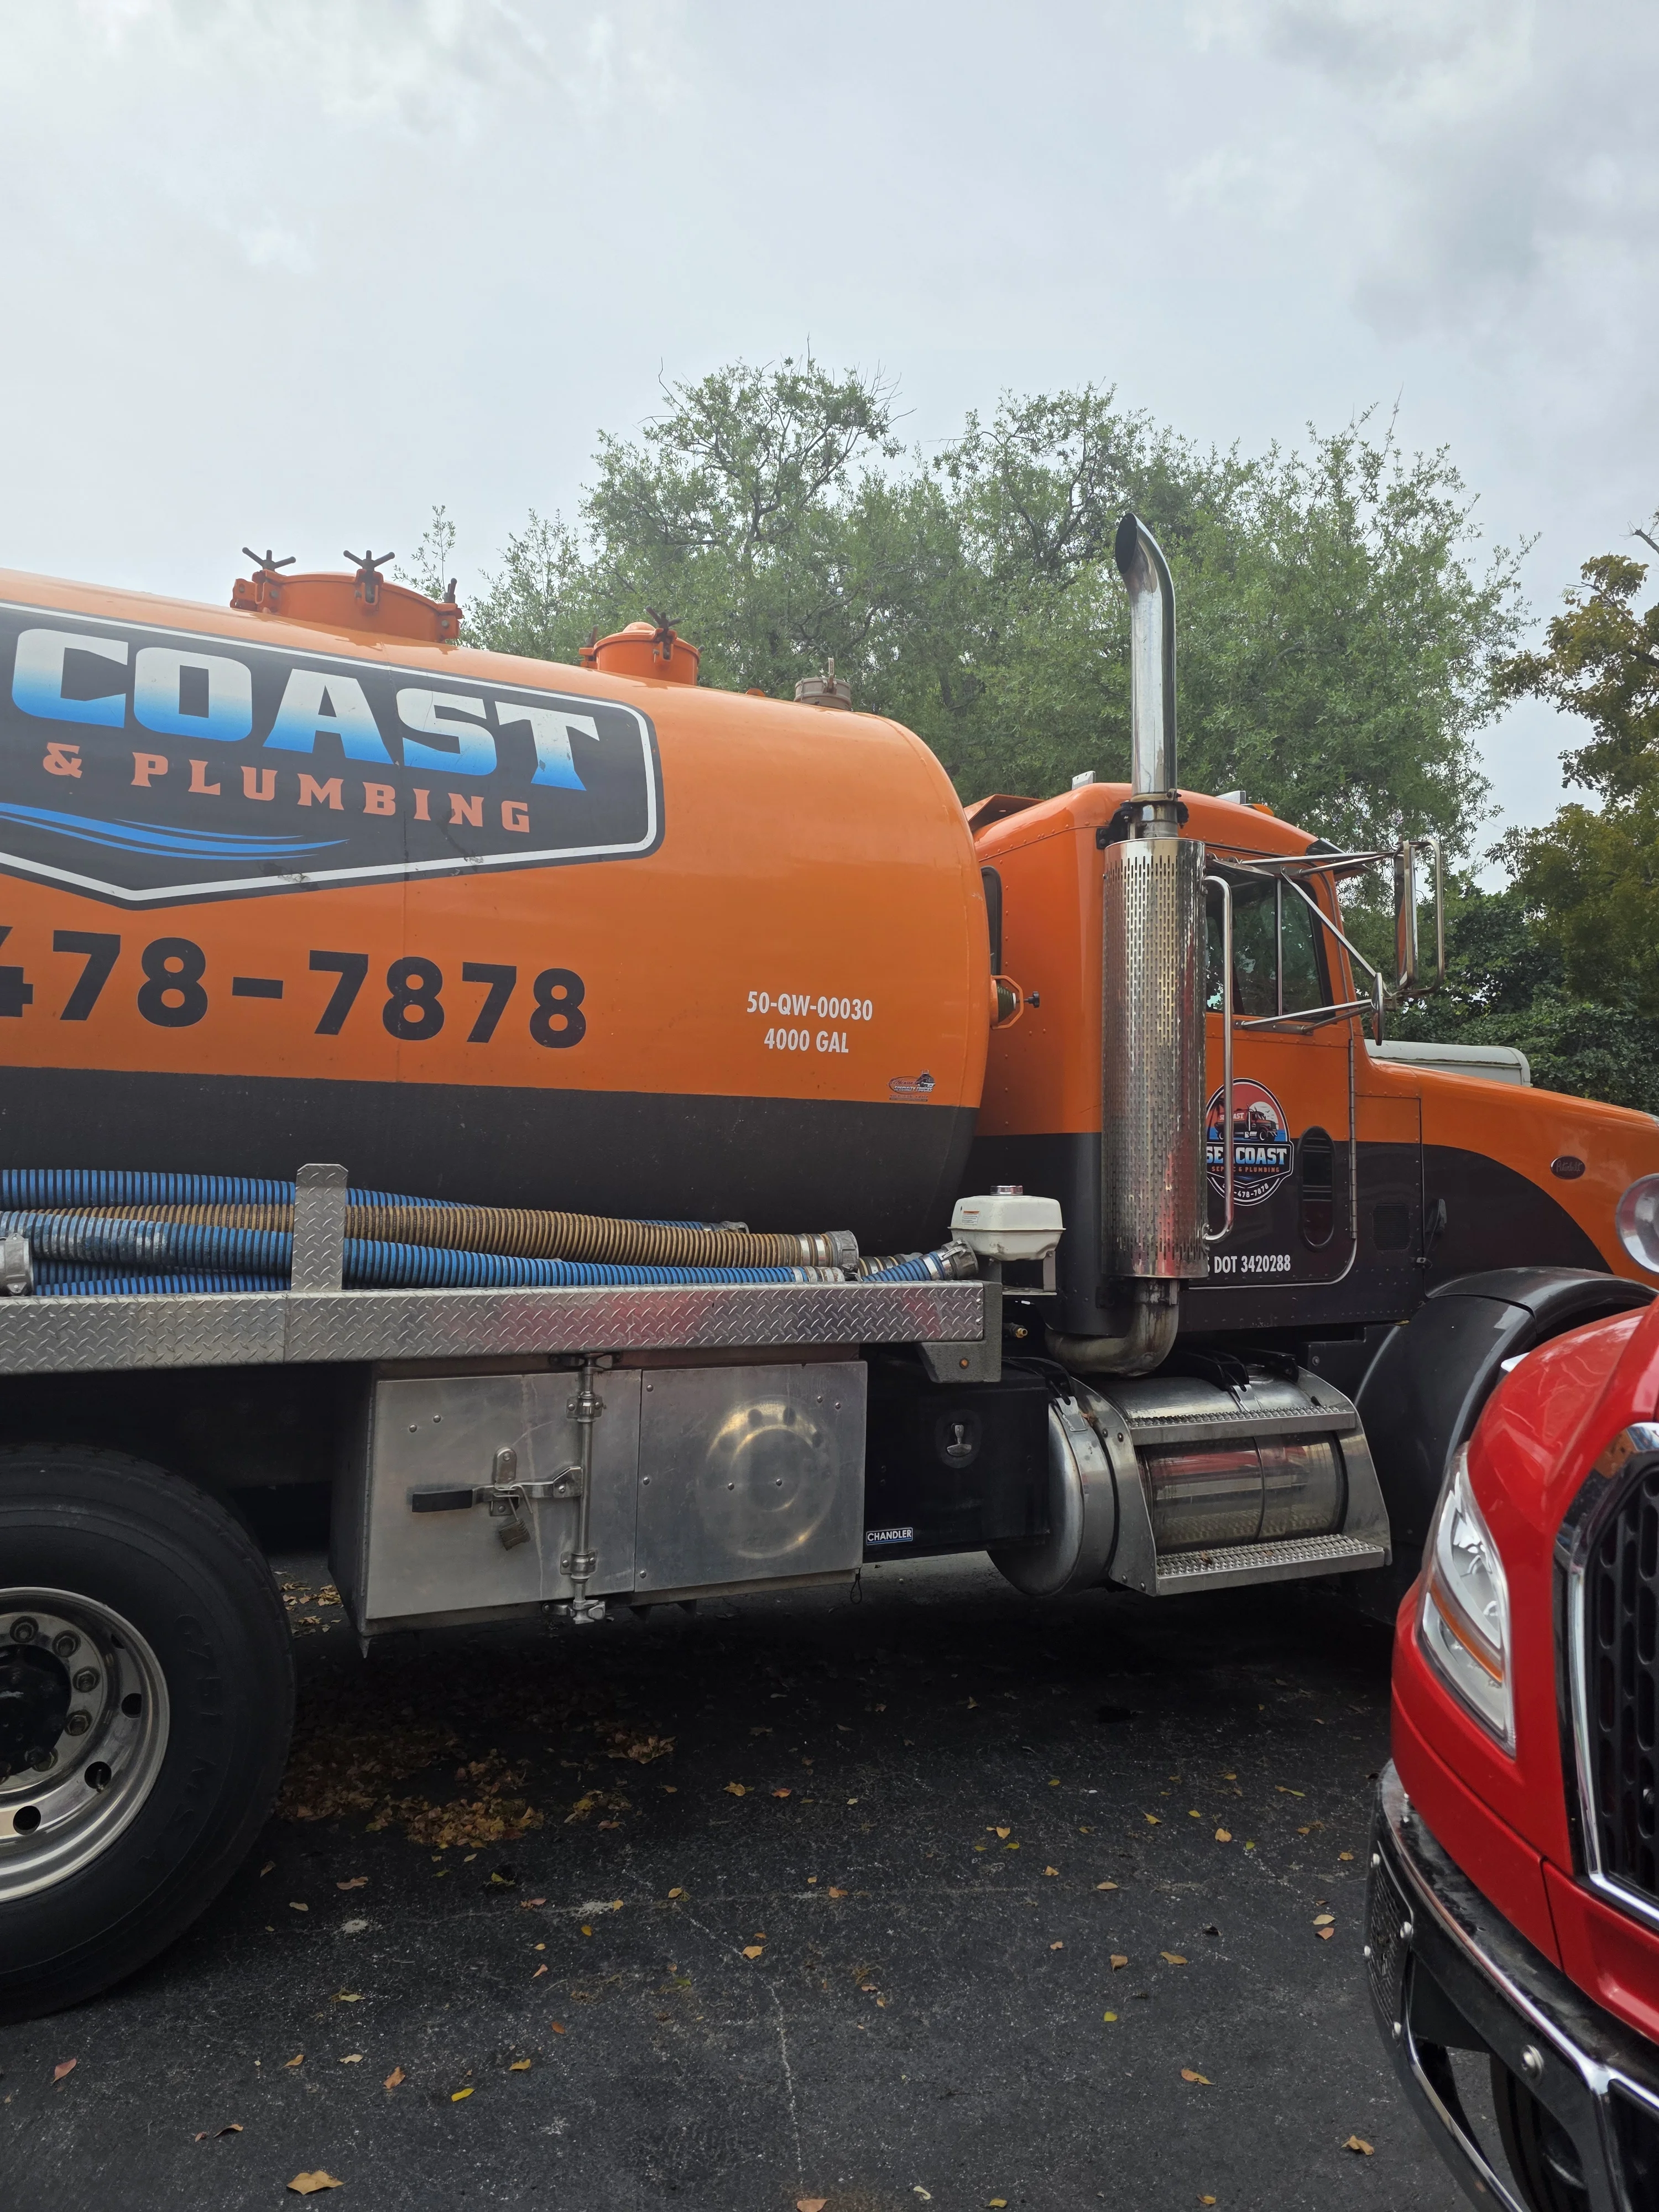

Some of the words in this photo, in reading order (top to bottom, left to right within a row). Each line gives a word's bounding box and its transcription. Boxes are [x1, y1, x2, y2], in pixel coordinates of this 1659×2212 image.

[12, 628, 600, 791] COAST
[43, 742, 83, 779] &
[131, 752, 531, 833] PLUMBING
[747, 990, 873, 1021] 50-QW-00030
[764, 1028, 810, 1050] 4000
[816, 1030, 849, 1053] GAL
[1206, 1146, 1287, 1165] SECOAST
[1556, 1160, 1583, 1173] Peterbilt
[1222, 1183, 1269, 1198] -478-7878
[1214, 1256, 1238, 1274] DOT
[1240, 1254, 1291, 1273] 3420288
[867, 1529, 912, 1542] CHANDLER
